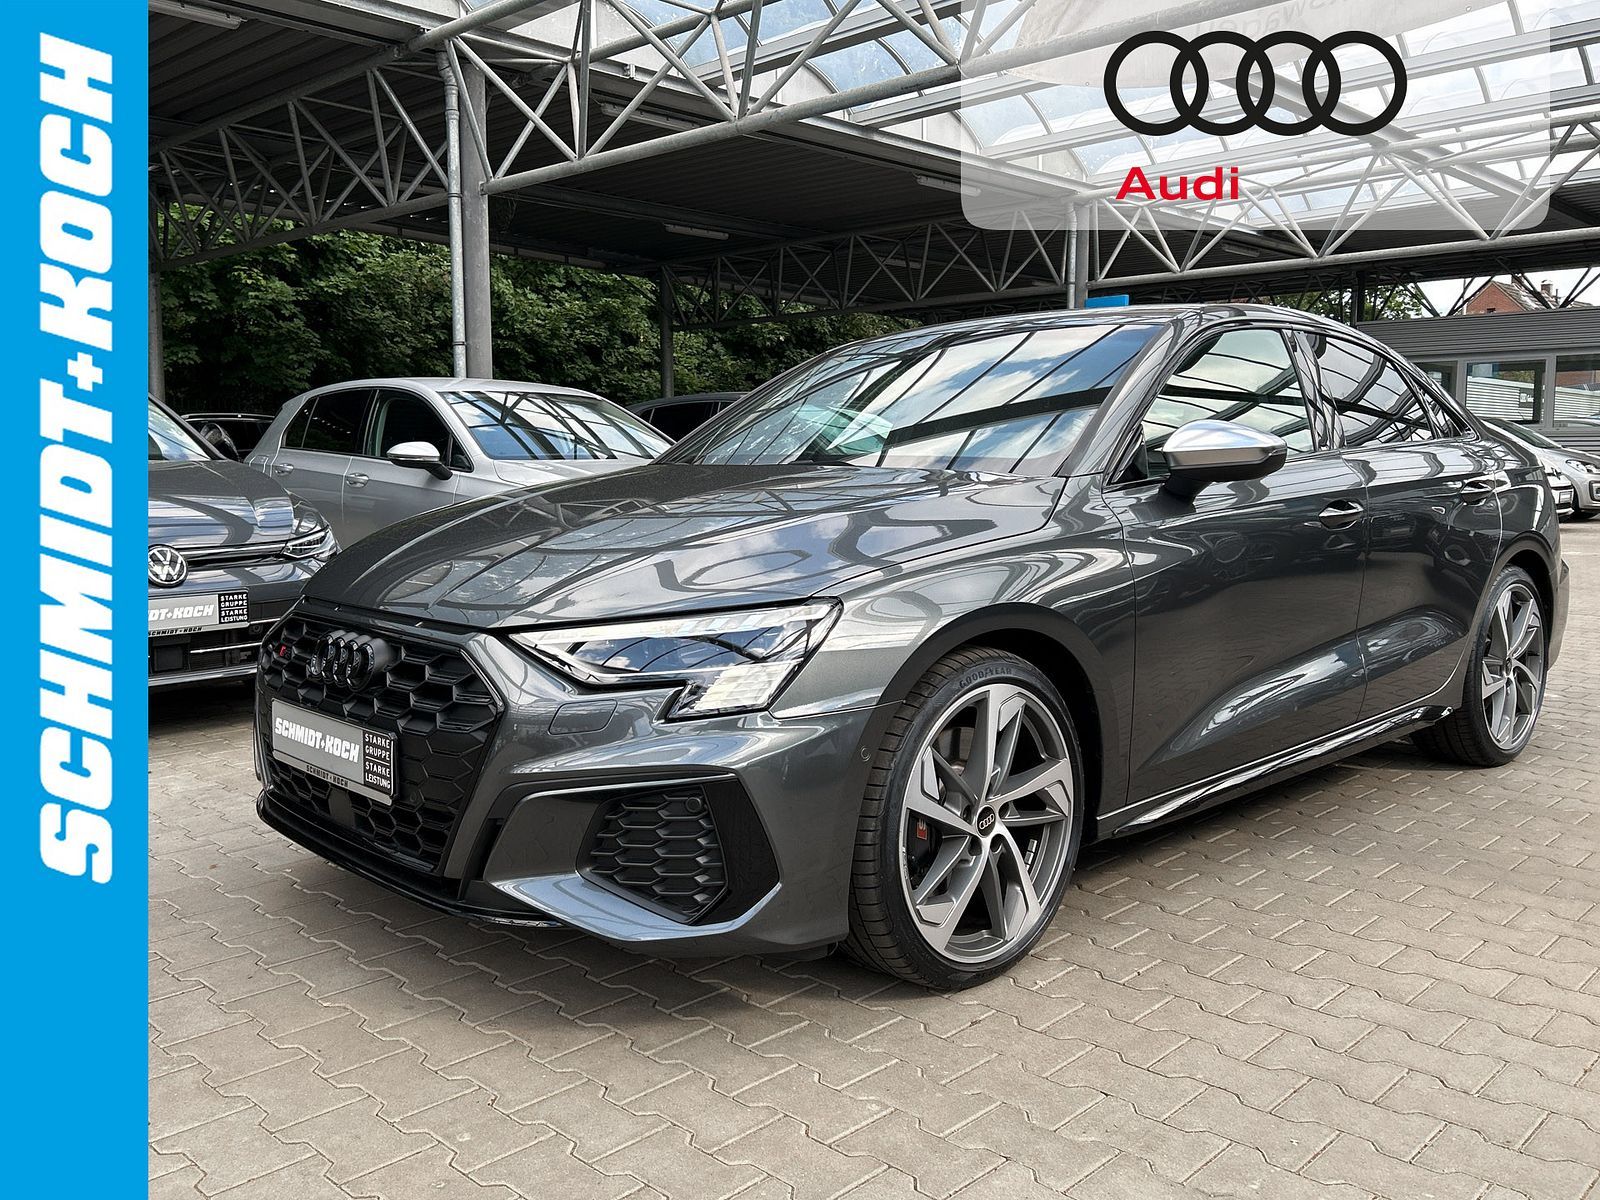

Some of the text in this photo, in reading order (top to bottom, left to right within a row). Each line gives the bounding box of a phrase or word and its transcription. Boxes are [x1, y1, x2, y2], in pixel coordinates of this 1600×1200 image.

[220, 593, 247, 601] STARKE
[220, 600, 248, 608] GRUPPE
[220, 608, 248, 617] STARKE
[959, 667, 1012, 688] GOODYEAR
[274, 717, 360, 763] SCHMIDT+KOCH
[364, 733, 391, 749] STARKE
[365, 745, 391, 761] GRUPPE
[365, 761, 391, 778] STARKE
[365, 772, 391, 789] LEISTUNG
